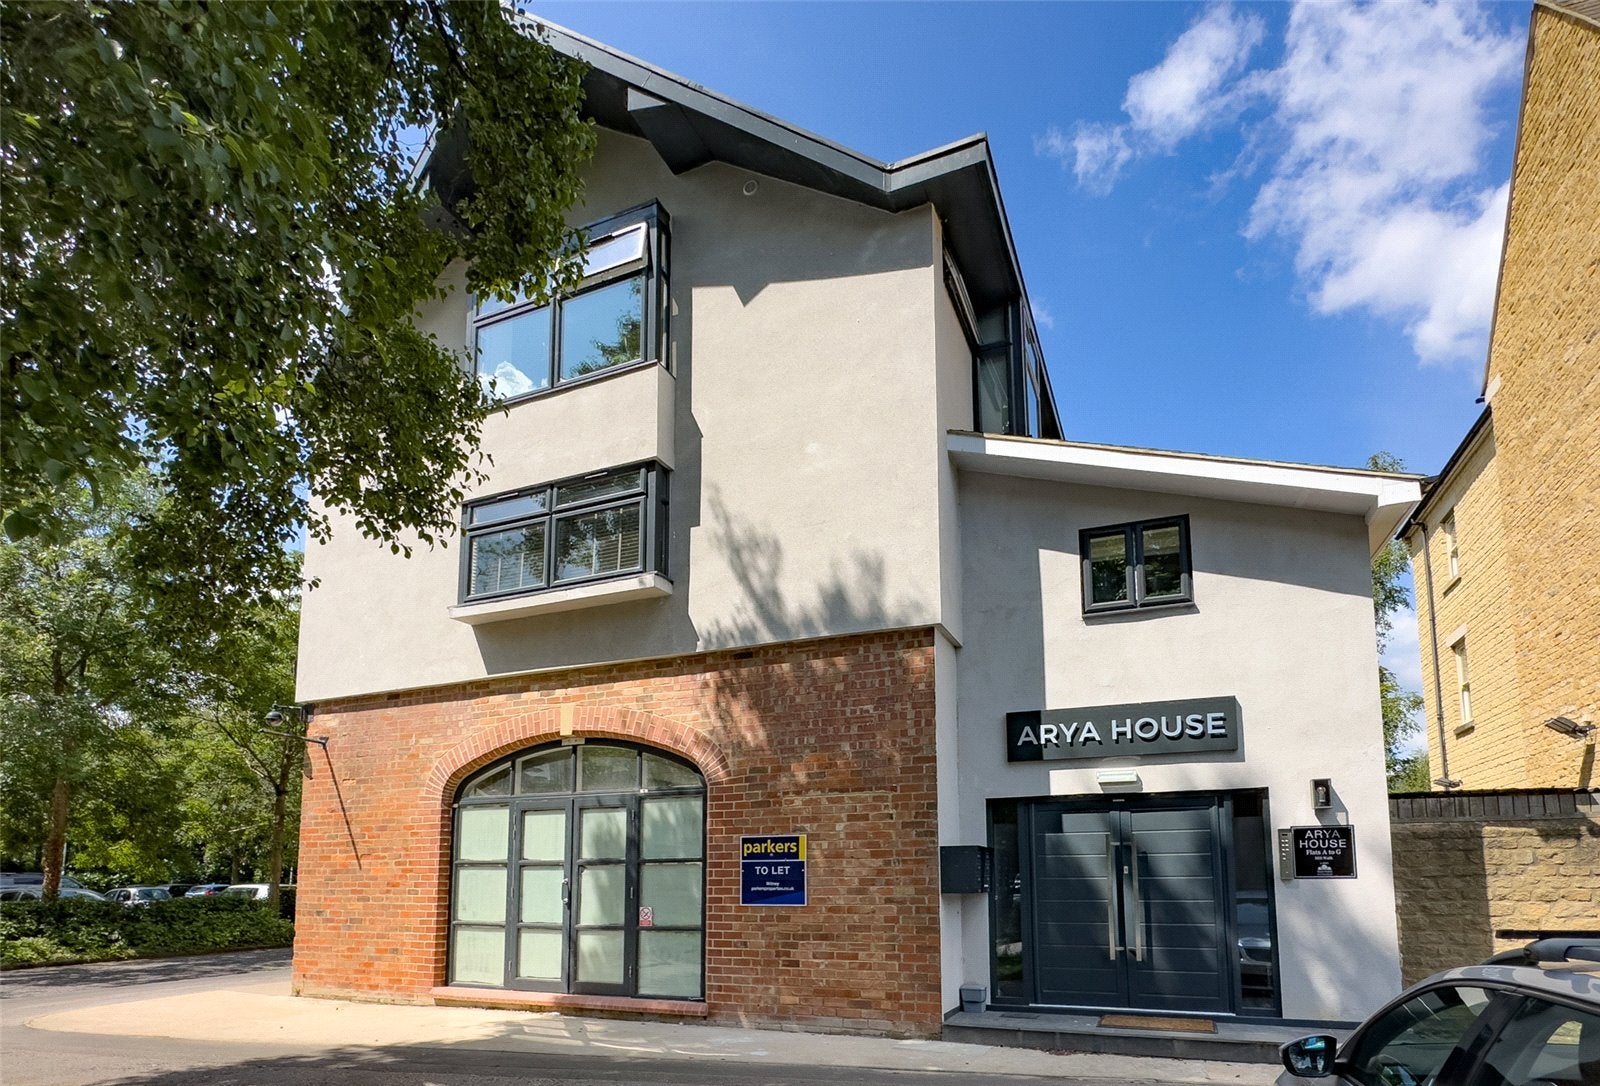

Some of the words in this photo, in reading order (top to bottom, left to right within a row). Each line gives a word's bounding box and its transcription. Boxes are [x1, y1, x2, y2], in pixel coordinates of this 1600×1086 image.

[1017, 721, 1101, 746] ARYA
[1111, 712, 1226, 740] HOUSE
[1305, 829, 1340, 839] ARYA
[743, 839, 797, 856] parkers
[1299, 839, 1347, 849] HOUSE
[754, 866, 769, 875] TO
[771, 866, 790, 875] LET
